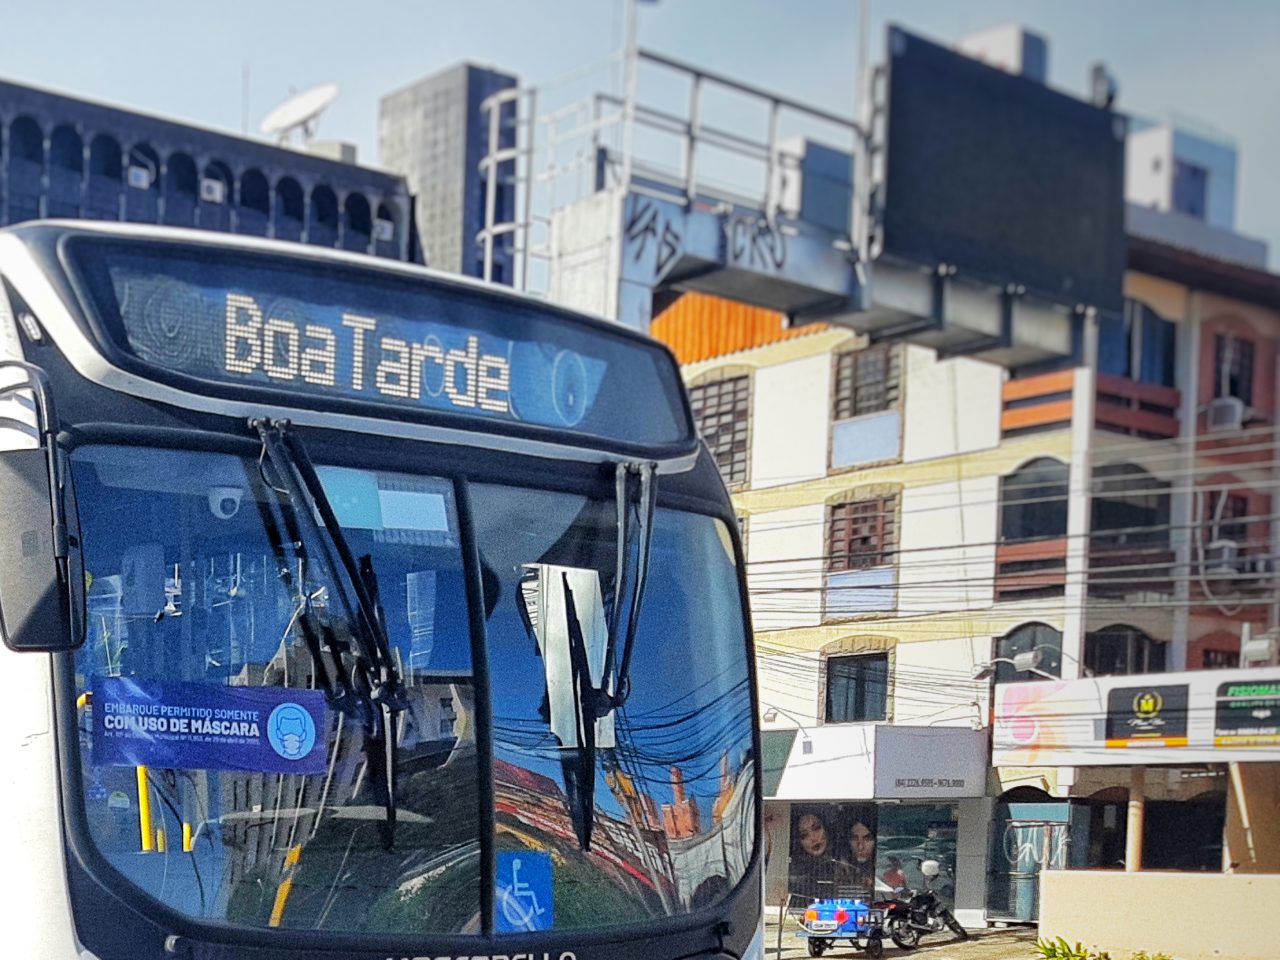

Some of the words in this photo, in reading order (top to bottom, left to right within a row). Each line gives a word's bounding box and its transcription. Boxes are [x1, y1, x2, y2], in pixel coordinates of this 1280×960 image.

[225, 292, 336, 386] Boa
[341, 312, 510, 413] Tarde
[104, 702, 160, 715] EMBARQUE
[160, 706, 213, 718] PERMITIDO
[214, 708, 259, 721] SOMENTE
[104, 715, 138, 730] COM
[138, 717, 167, 732] USO
[170, 719, 190, 733] DE
[191, 717, 260, 737] MÁSCARA
